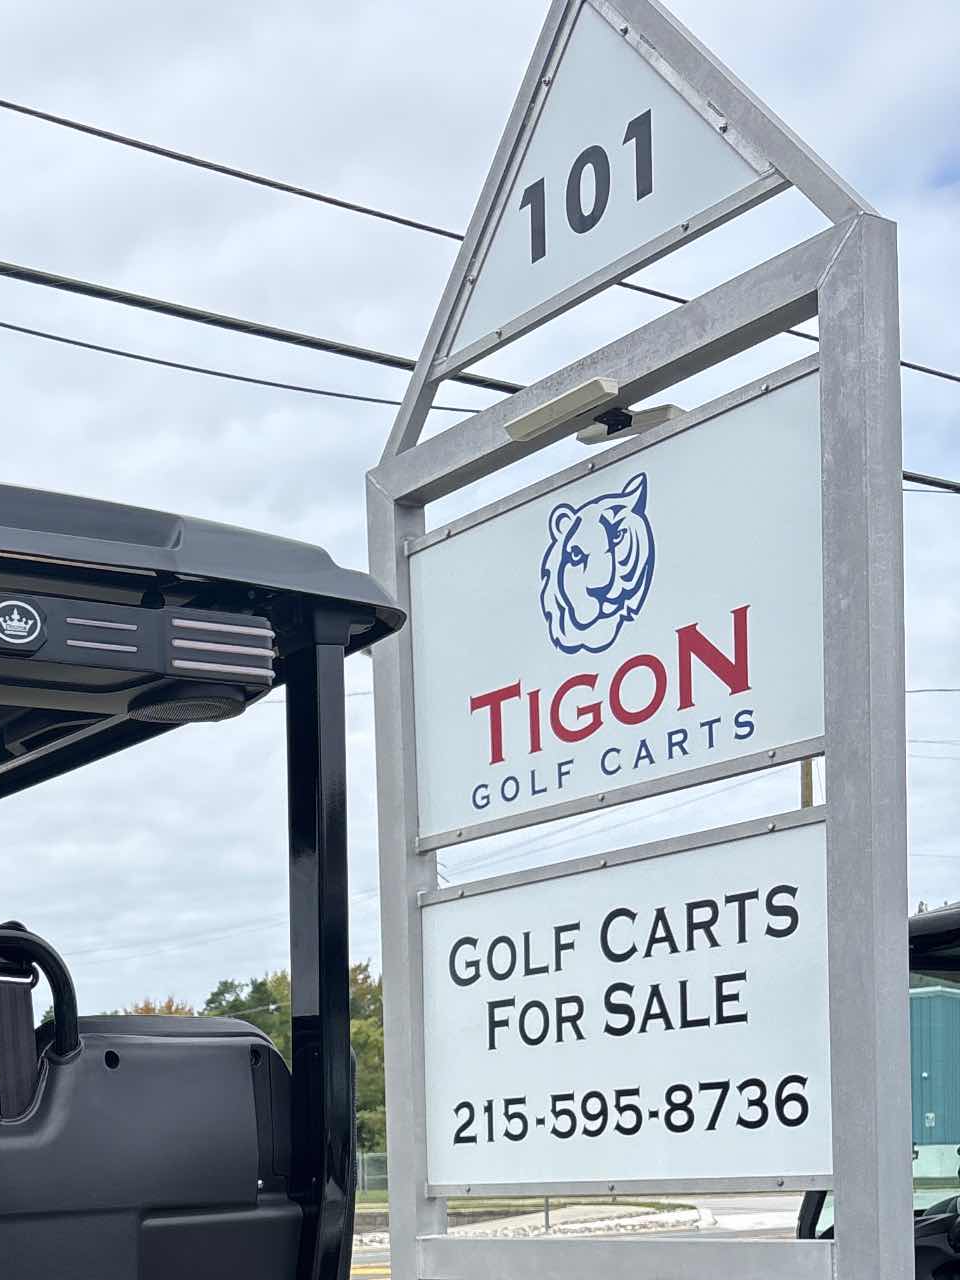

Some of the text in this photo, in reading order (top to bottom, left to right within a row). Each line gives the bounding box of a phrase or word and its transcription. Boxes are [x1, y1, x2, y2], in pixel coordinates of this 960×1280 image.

[519, 108, 653, 265] 101
[470, 606, 753, 766] TIGON
[471, 709, 755, 810] GOLF CARTS
[448, 884, 799, 987] GOLF CARTS
[486, 969, 749, 1051] FOR SALE
[453, 1074, 810, 1145] 215-595-8736
